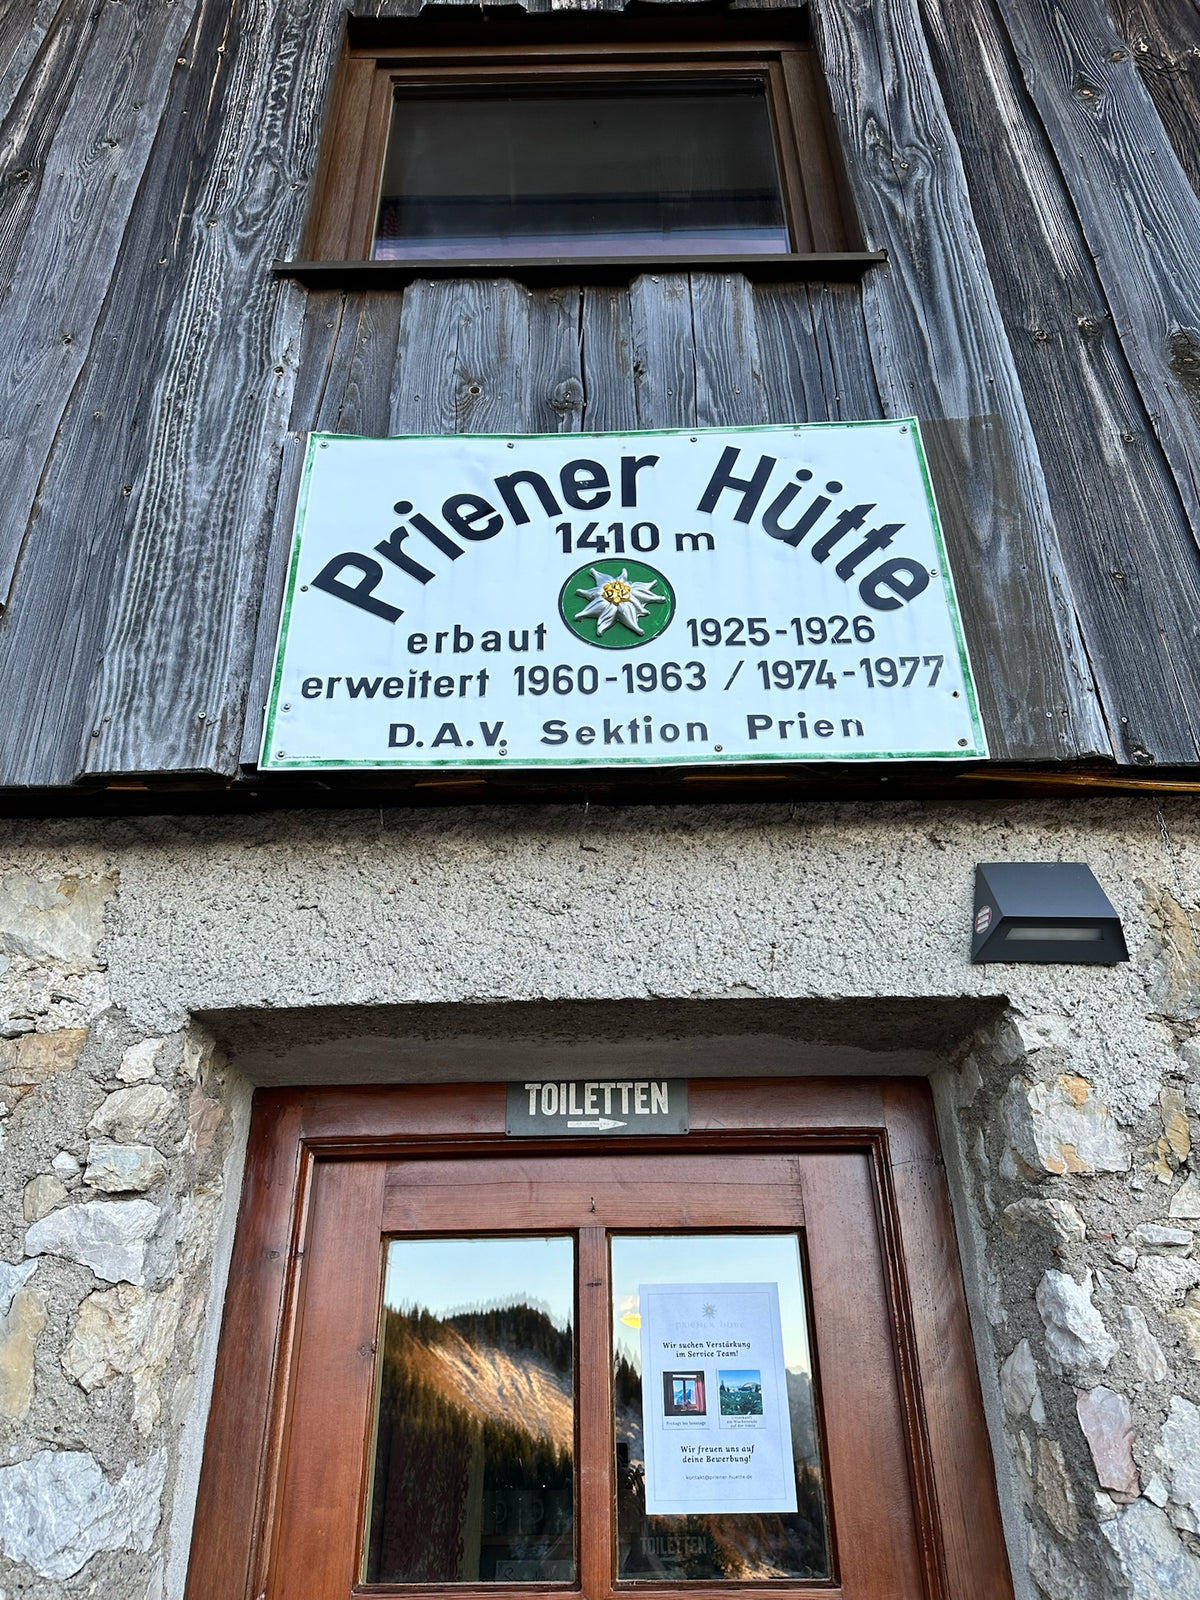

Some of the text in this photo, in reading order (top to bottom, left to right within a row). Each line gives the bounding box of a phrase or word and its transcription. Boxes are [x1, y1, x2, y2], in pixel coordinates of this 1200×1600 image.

[311, 446, 930, 624] Priener Hütte
[555, 522, 715, 554] 1410 m
[407, 615, 875, 654] erbaut 1925-1926
[301, 655, 944, 699] erweitert 1960-1963 / 1974-1977
[388, 712, 864, 748] D.A.V. Sektion Prien
[524, 1082, 669, 1115] TOILETTEN
[676, 1350, 739, 1358] im Service Team!
[679, 1341, 704, 1349] suchen
[706, 1341, 751, 1350] Verstärkung
[680, 1445, 696, 1453] Wir
[698, 1444, 723, 1455] freuen
[741, 1444, 755, 1454] auf
[682, 1454, 751, 1464] deine Bewerbung!
